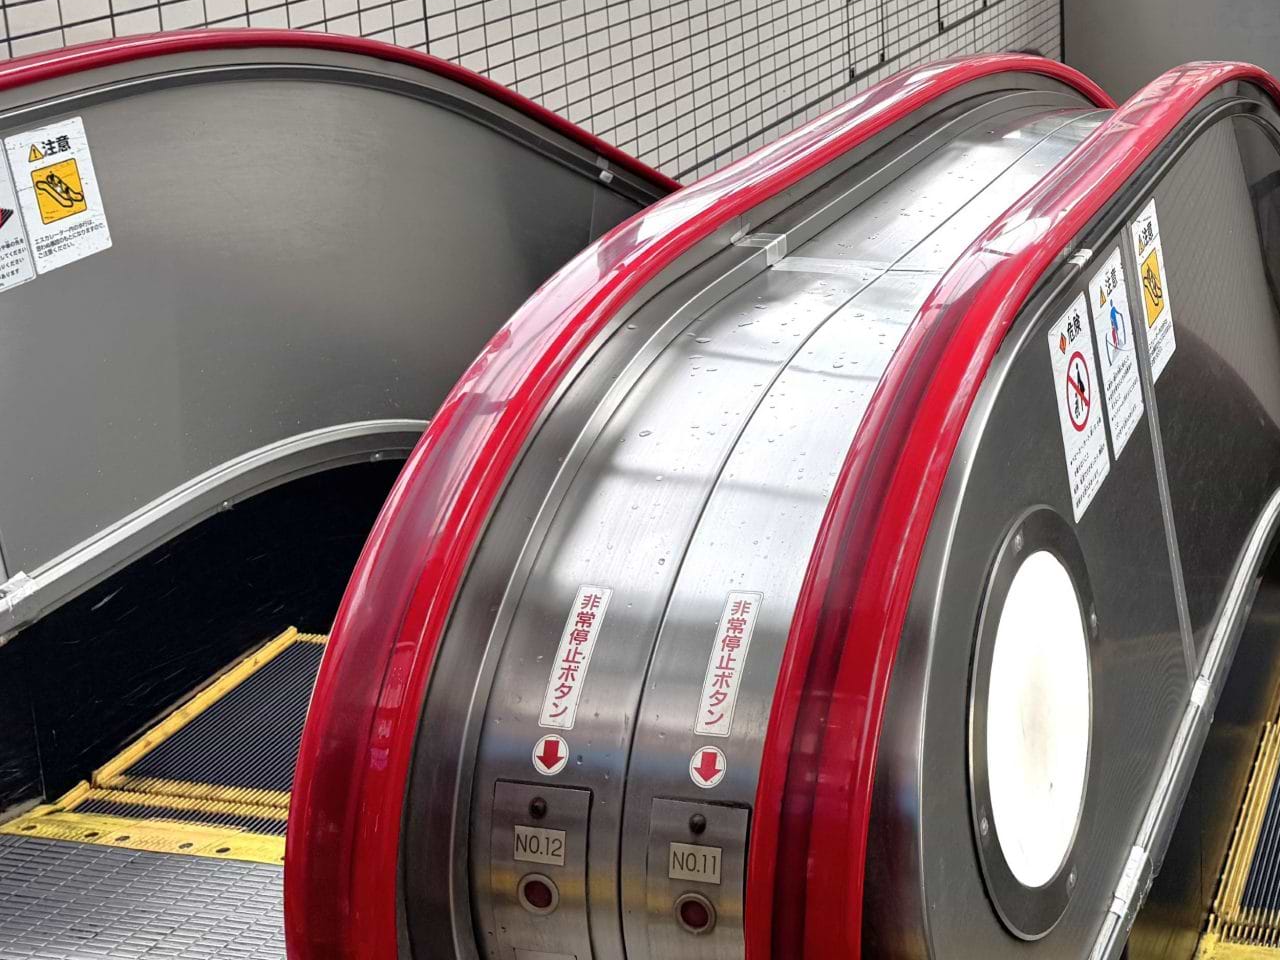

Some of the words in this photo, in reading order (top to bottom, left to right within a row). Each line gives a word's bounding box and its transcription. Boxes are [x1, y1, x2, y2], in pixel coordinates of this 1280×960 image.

[41, 134, 71, 157] 注意
[1104, 267, 1118, 297] 注意
[1067, 314, 1082, 346] 危険
[548, 593, 602, 719] 非常停止ボタン
[704, 599, 752, 727] 非常停止ボタン
[515, 833, 563, 858] NO.12
[672, 850, 717, 875] NO.11
